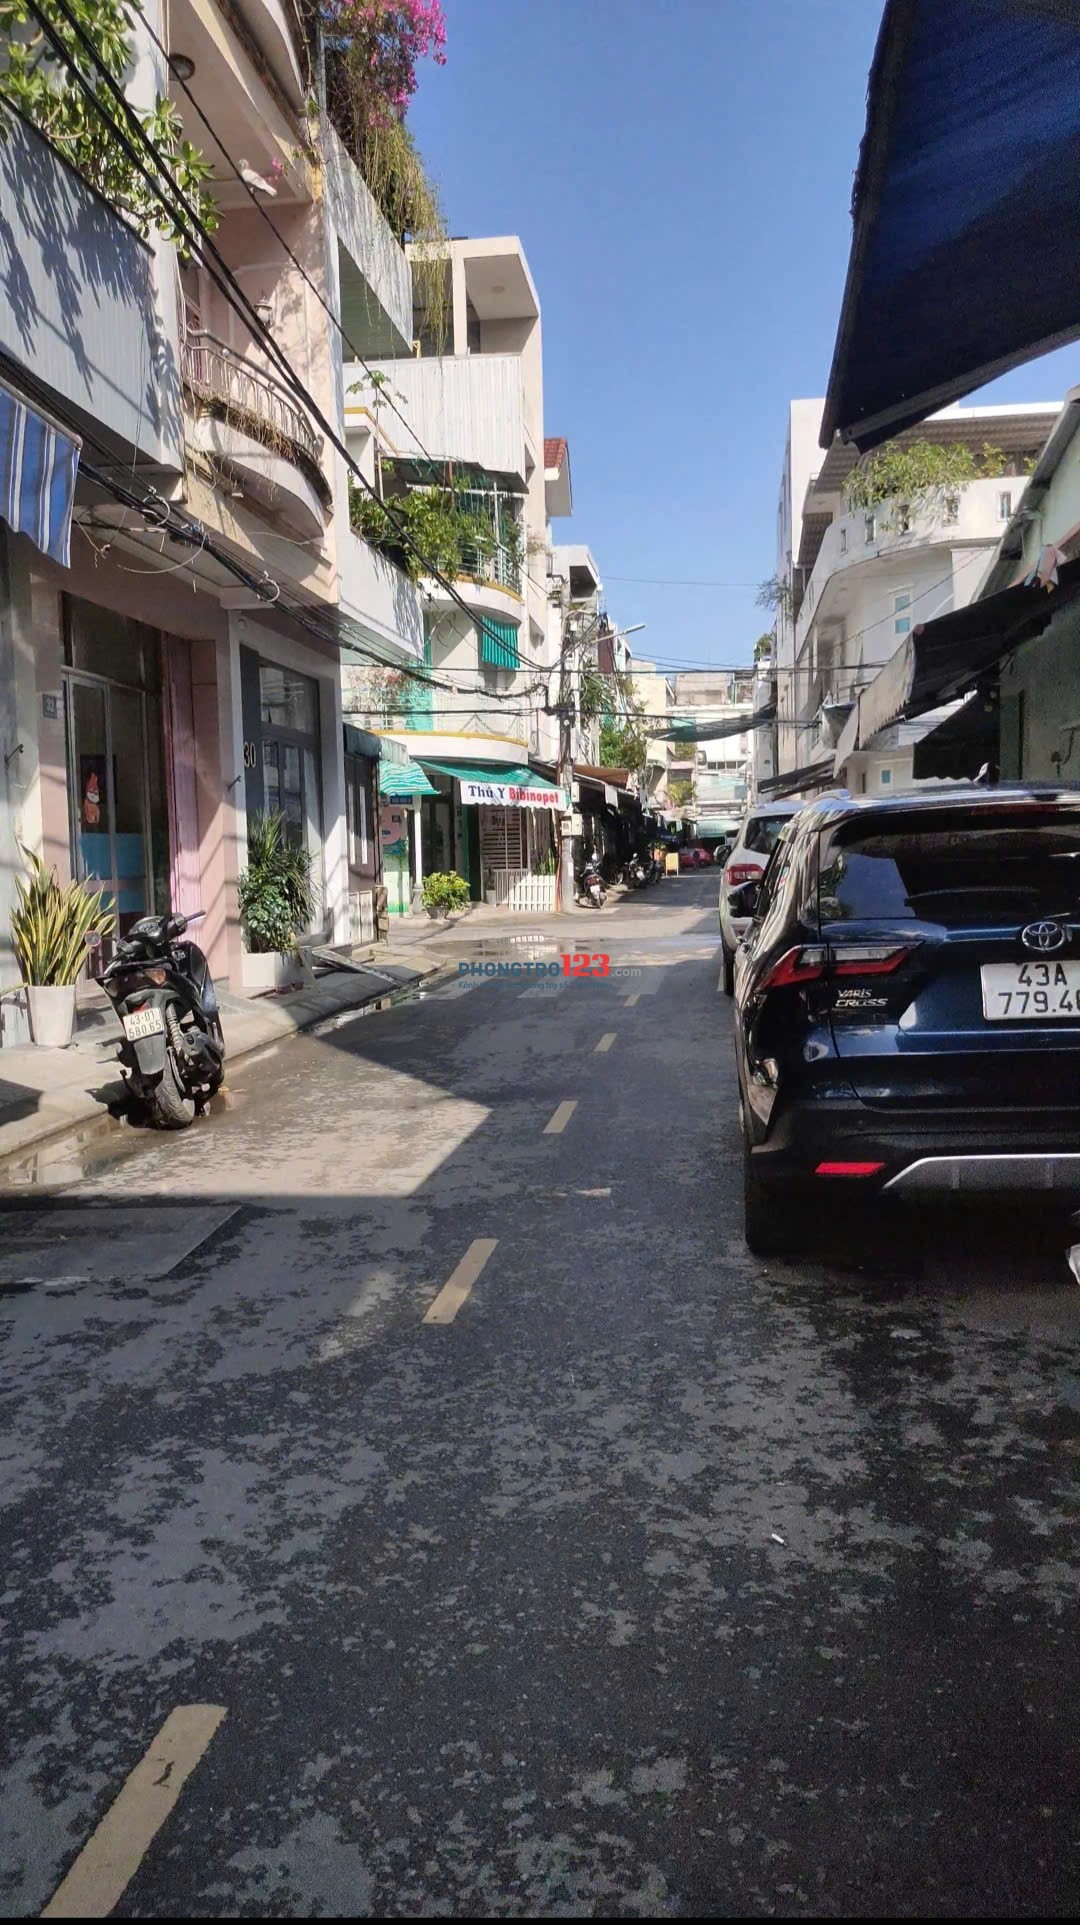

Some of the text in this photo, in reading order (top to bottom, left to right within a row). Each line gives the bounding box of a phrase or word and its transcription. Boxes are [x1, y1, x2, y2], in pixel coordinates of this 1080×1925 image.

[243, 741, 256, 768] 30
[497, 787, 506, 799] Y
[1018, 963, 1068, 987] 43A
[835, 998, 889, 1007] CROSS
